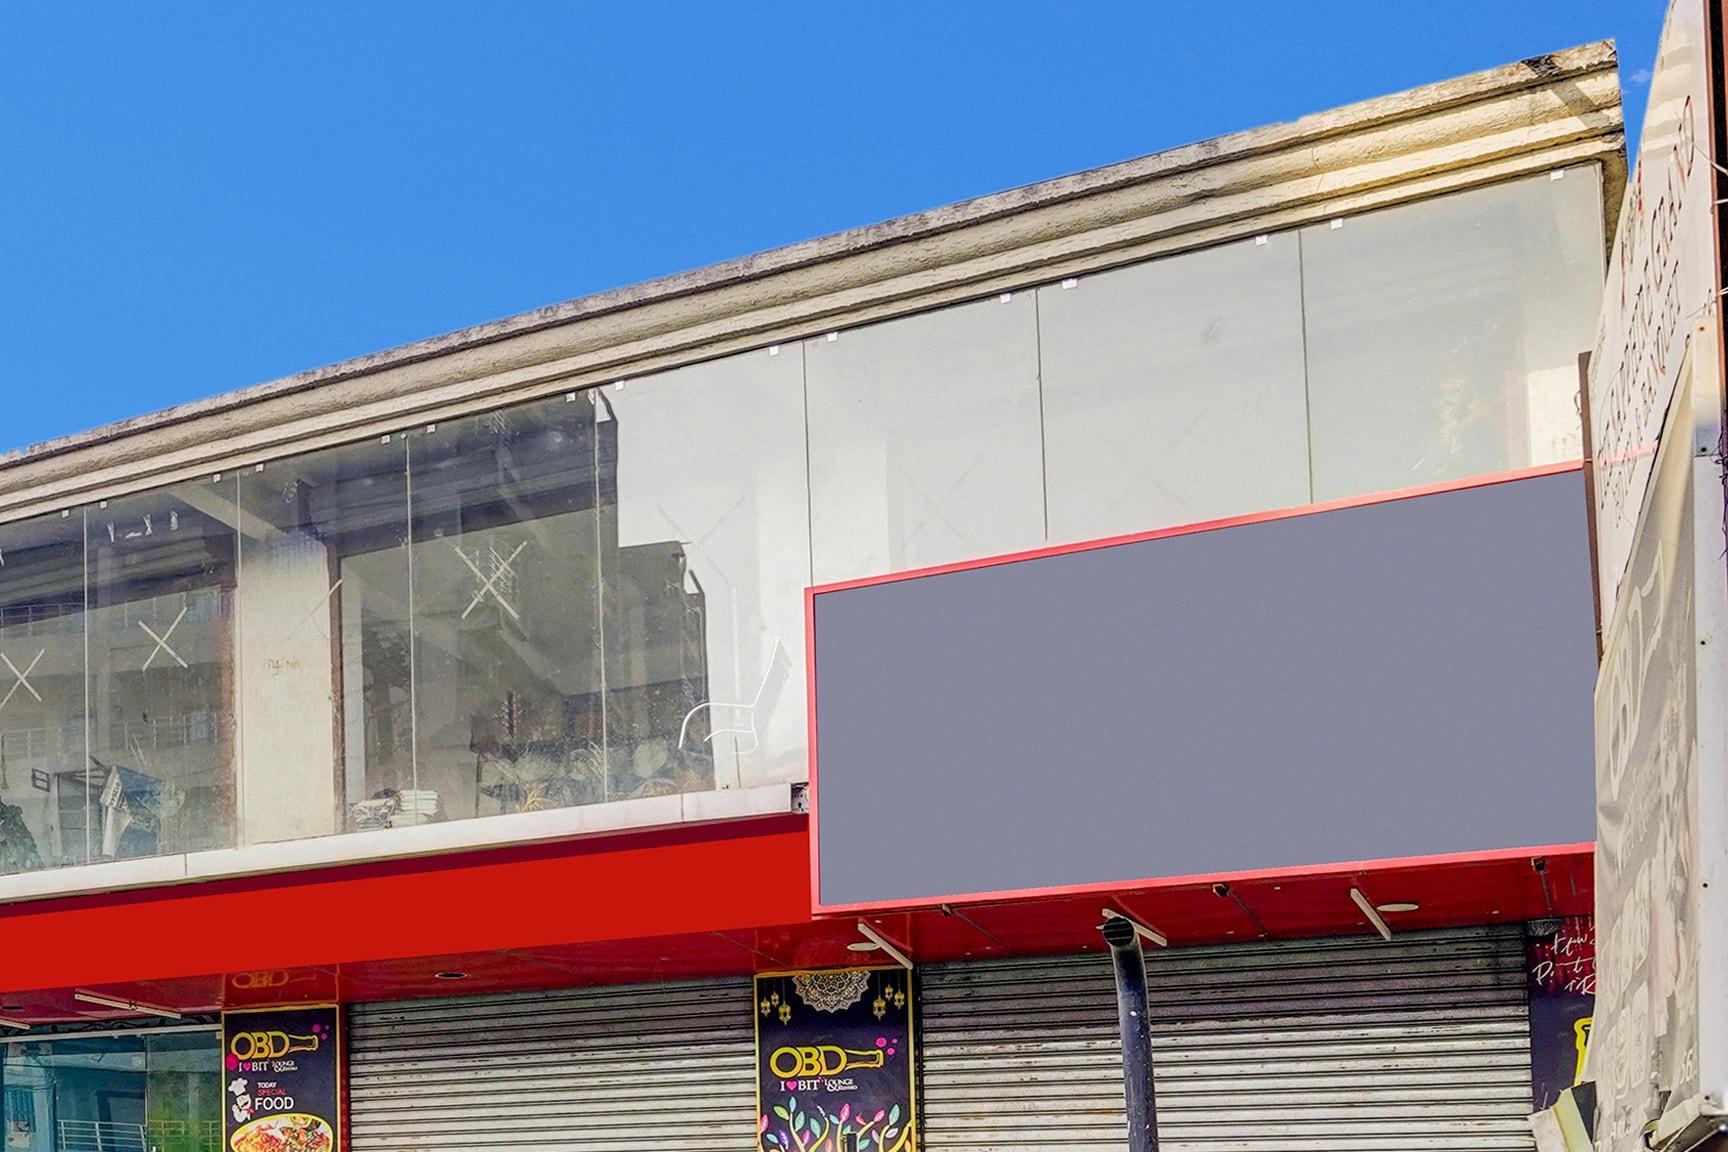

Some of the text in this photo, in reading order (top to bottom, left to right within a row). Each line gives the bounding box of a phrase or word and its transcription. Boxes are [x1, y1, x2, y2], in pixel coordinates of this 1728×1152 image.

[1651, 94, 1694, 287] GRAND
[230, 1031, 290, 1061] OBD
[252, 1061, 269, 1072] BIT
[769, 1045, 848, 1079] OBD
[798, 1080, 820, 1091] BIT
[255, 1096, 295, 1111] FOOD
